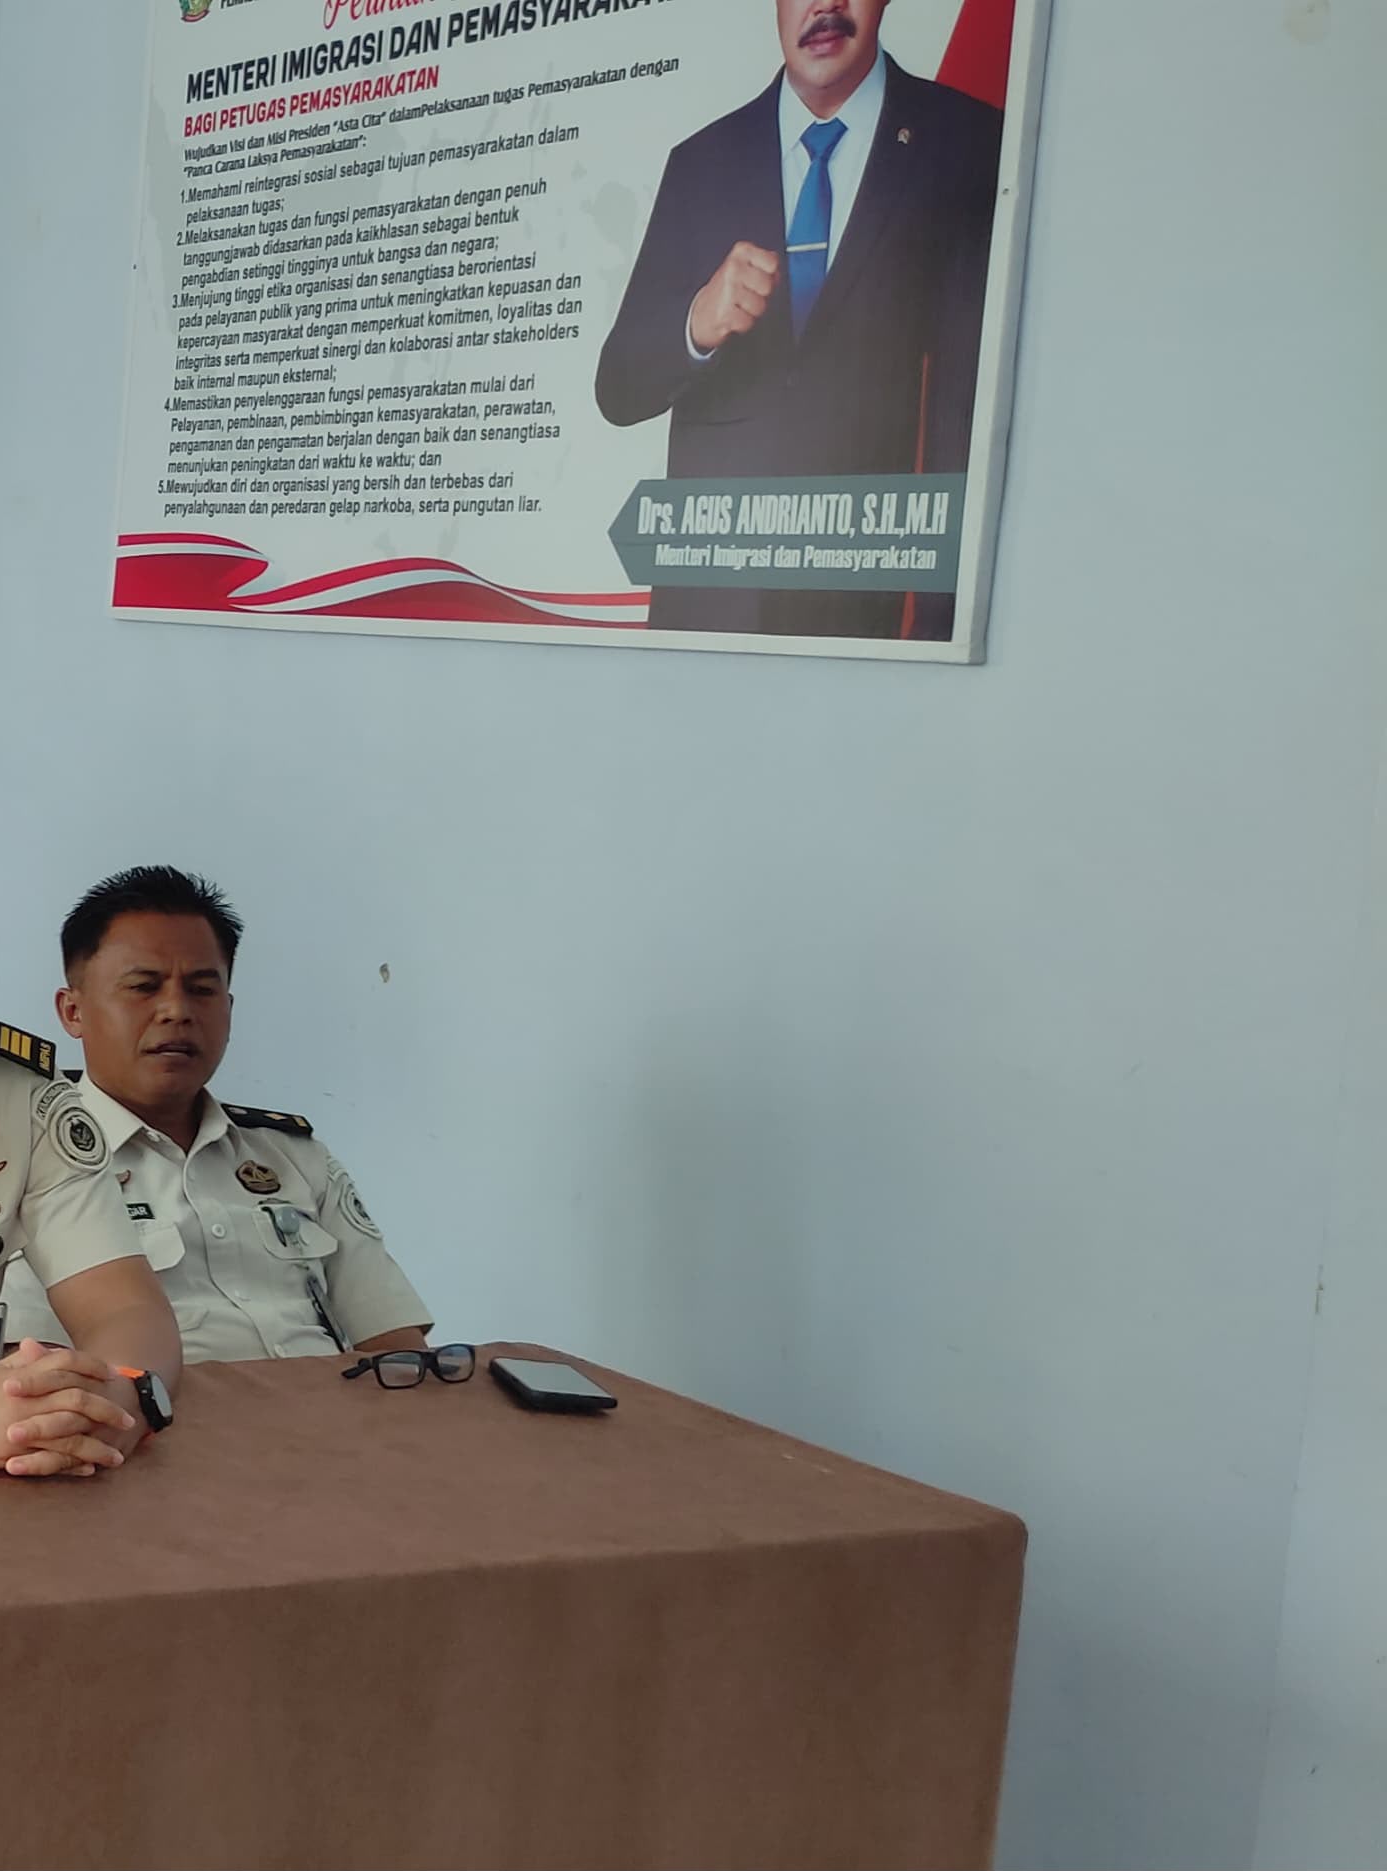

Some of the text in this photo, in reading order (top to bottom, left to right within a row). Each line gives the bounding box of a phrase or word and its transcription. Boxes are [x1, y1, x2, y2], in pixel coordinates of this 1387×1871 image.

[186, 17, 441, 104] MENTERI IMIGRASI DAN
[183, 66, 439, 137] BAGI PETUGAS PEMASYARAKATAN
[244, 170, 302, 194] reintegrasi
[303, 164, 338, 184] sosial
[339, 155, 386, 178] sebagai
[387, 152, 426, 172] tujuan
[428, 132, 534, 168] pemasyarakatan
[537, 125, 579, 146] dalam
[187, 200, 284, 226] pelaksanaan tugas;
[258, 220, 289, 237] tugas
[290, 214, 312, 230] dan
[313, 207, 350, 228] fungsi
[351, 194, 451, 225] pemasyarakatan
[453, 188, 502, 208] dengan
[504, 177, 547, 204] penuh
[183, 242, 261, 268] tanggungjawab
[262, 235, 323, 256] didasarkan
[324, 230, 354, 251] pada
[422, 212, 472, 234] sebagai
[474, 205, 519, 227] bentuk
[181, 237, 499, 290] pengabdian setinggi tingginya untuk bangsa dan negara;
[234, 284, 265, 304] tinggi
[266, 281, 293, 298] etika
[295, 273, 354, 297] organisasi
[355, 272, 378, 288] dan
[381, 264, 455, 286] senangtiasa
[457, 252, 537, 277] berorientasi
[176, 298, 583, 352] kepercayaan masyarakat dengan memperkuat komitmen, loyalitas dan
[178, 274, 581, 332] pada pelayanan publik yang prima untuk meningkatkan kepuasan dan
[175, 323, 579, 372] integritas serta memperkuat sinergi dan kolaborasi antar stakeholders
[173, 365, 337, 391] baik internal maupun eksternal;
[233, 391, 326, 411] penyelenggaraan
[328, 385, 365, 405] fungsi
[367, 379, 467, 404] pemasyarakatan
[470, 376, 506, 394] mulai
[509, 374, 535, 392] dari
[169, 422, 561, 456] pengamanan dan pengamatan berjalan dengan baik dan senangtiasa
[170, 417, 224, 434] Pelayanan,
[290, 409, 374, 430] pembimbingan
[376, 403, 479, 425] kemasyarakatan,
[483, 399, 555, 422] perawatan,
[230, 456, 296, 475] peningkatan
[298, 454, 320, 470] dari
[322, 453, 356, 469] waktu
[359, 453, 373, 468] ke
[375, 451, 415, 469] waktu;
[418, 451, 442, 467] dan
[230, 478, 248, 493] diri
[249, 478, 270, 492] dan
[271, 476, 330, 496] organisasi
[332, 479, 361, 495] yang
[363, 474, 401, 490] bersih
[403, 474, 426, 490] dan
[429, 473, 485, 489] terbebas
[488, 472, 514, 488] dari
[248, 500, 269, 514] dan
[270, 499, 327, 517] peredaran
[329, 498, 361, 517] gelap
[363, 497, 415, 515] narkoba,
[418, 497, 450, 513] serta
[452, 496, 515, 517] pungutan
[518, 495, 541, 512] liar.
[637, 497, 676, 535] Drs.
[681, 496, 733, 535] AGUS
[736, 495, 855, 538] ANDRIANTO,
[655, 544, 937, 574] Menteri Imigrasi dan Pemasyarakatan
